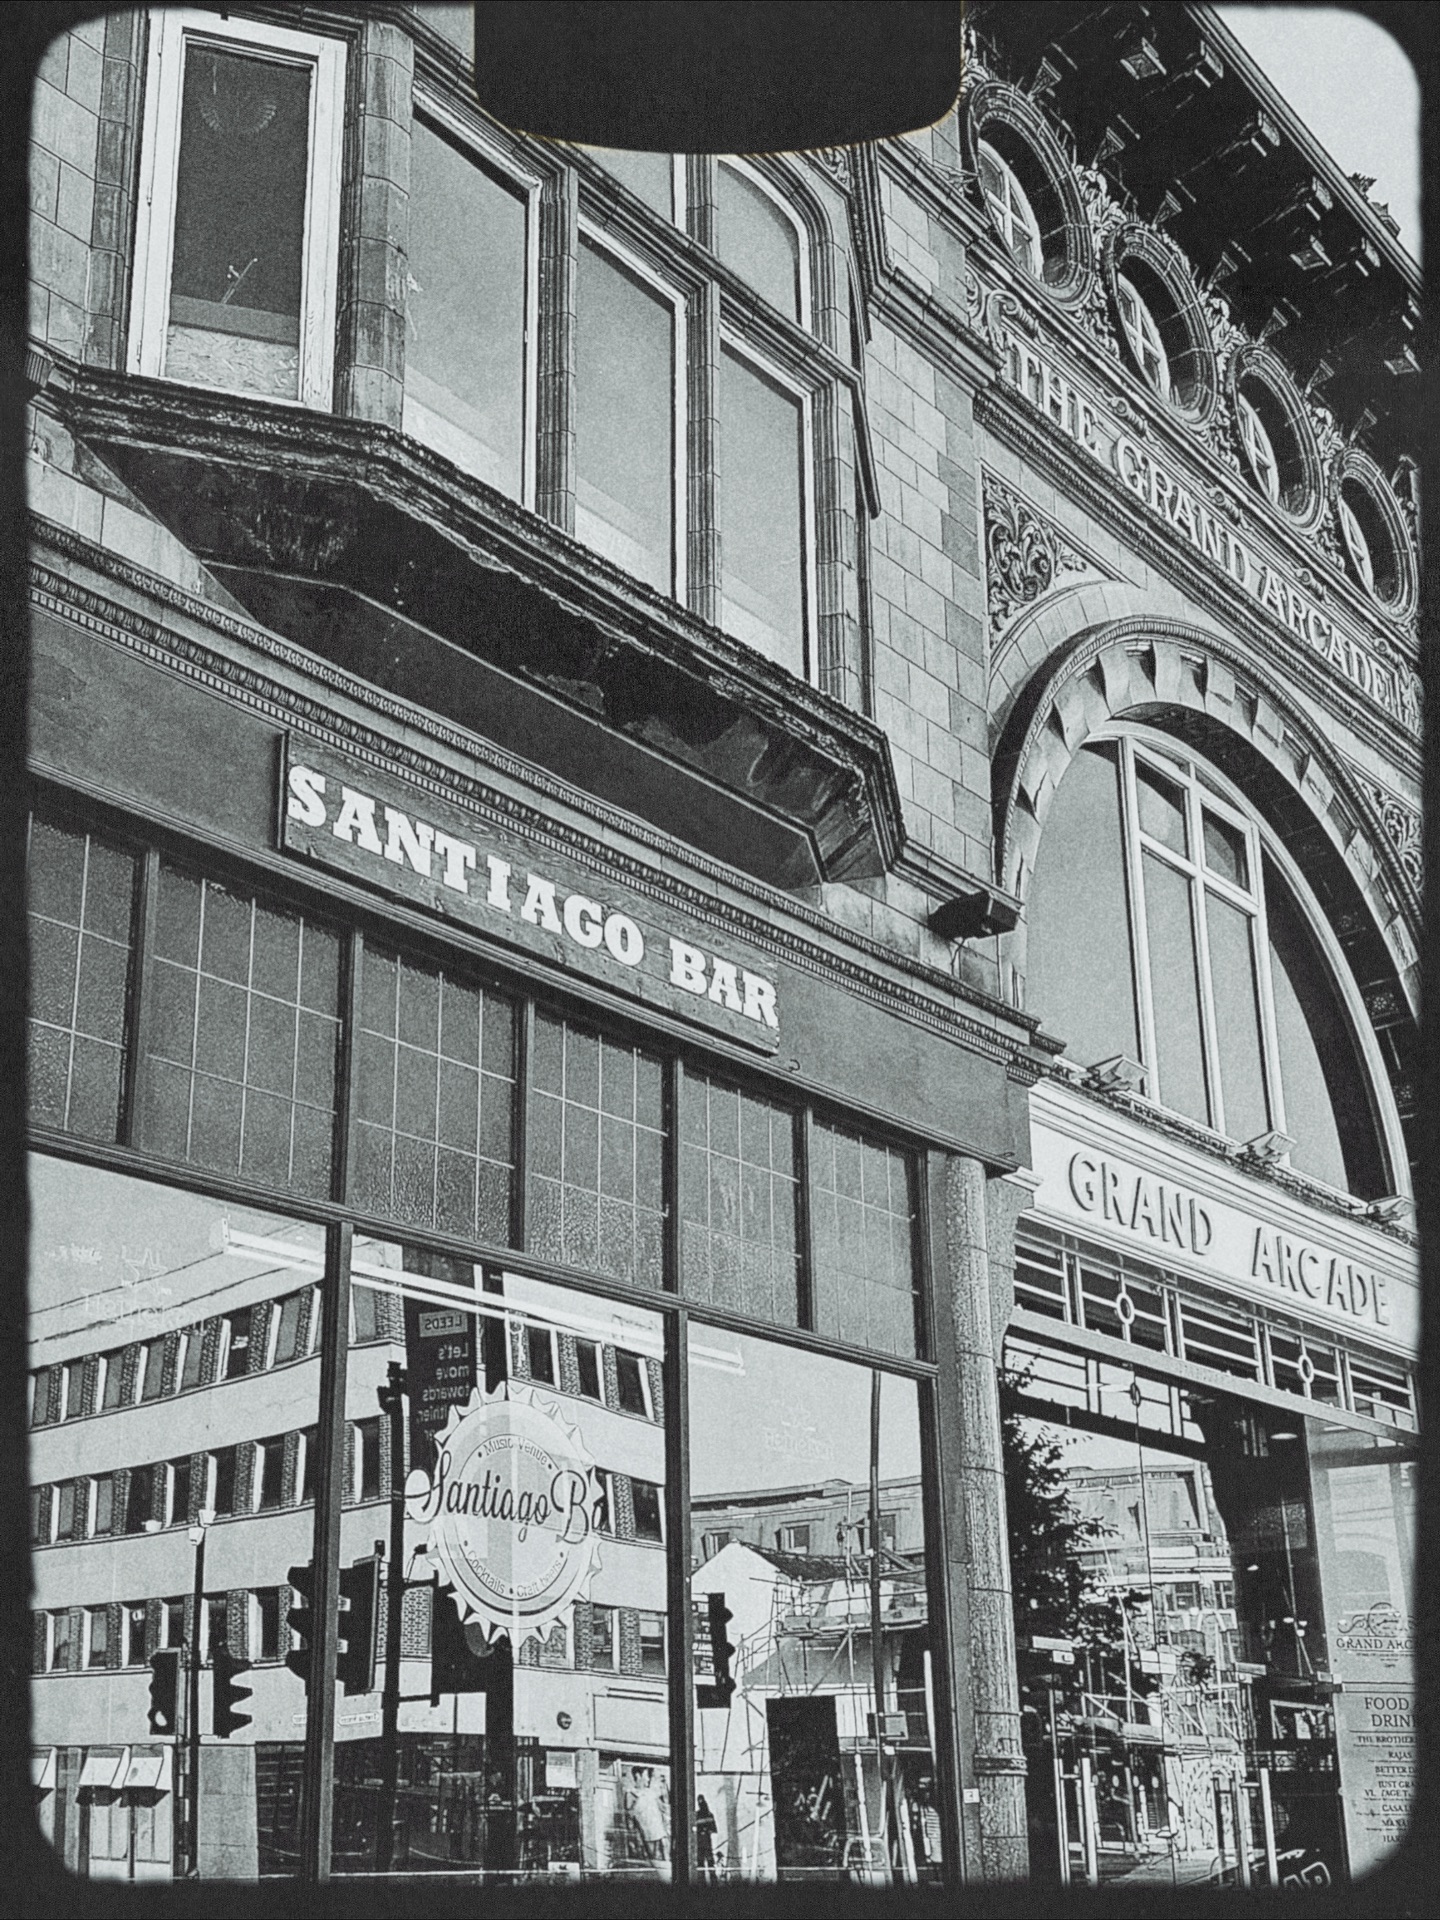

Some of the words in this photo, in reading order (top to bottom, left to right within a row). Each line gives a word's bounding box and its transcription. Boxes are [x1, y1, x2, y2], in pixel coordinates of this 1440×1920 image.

[1012, 339, 1102, 461] THE
[1115, 436, 1250, 587] GRAND
[1260, 565, 1392, 709] ARCADE
[287, 765, 645, 967] SANTIAGO
[669, 938, 779, 1030] BAR
[1068, 1150, 1212, 1256] GRAND
[1251, 1226, 1391, 1326] ARCADE
[483, 1438, 514, 1456] Music
[518, 1437, 548, 1466] Venue
[402, 1450, 551, 1543] Santiago
[467, 1550, 506, 1595] Cocktails
[516, 1581, 540, 1598] Craft
[1336, 1637, 1383, 1649] GRAND
[1386, 1638, 1414, 1650] ARC
[1364, 1696, 1410, 1711] FOOD
